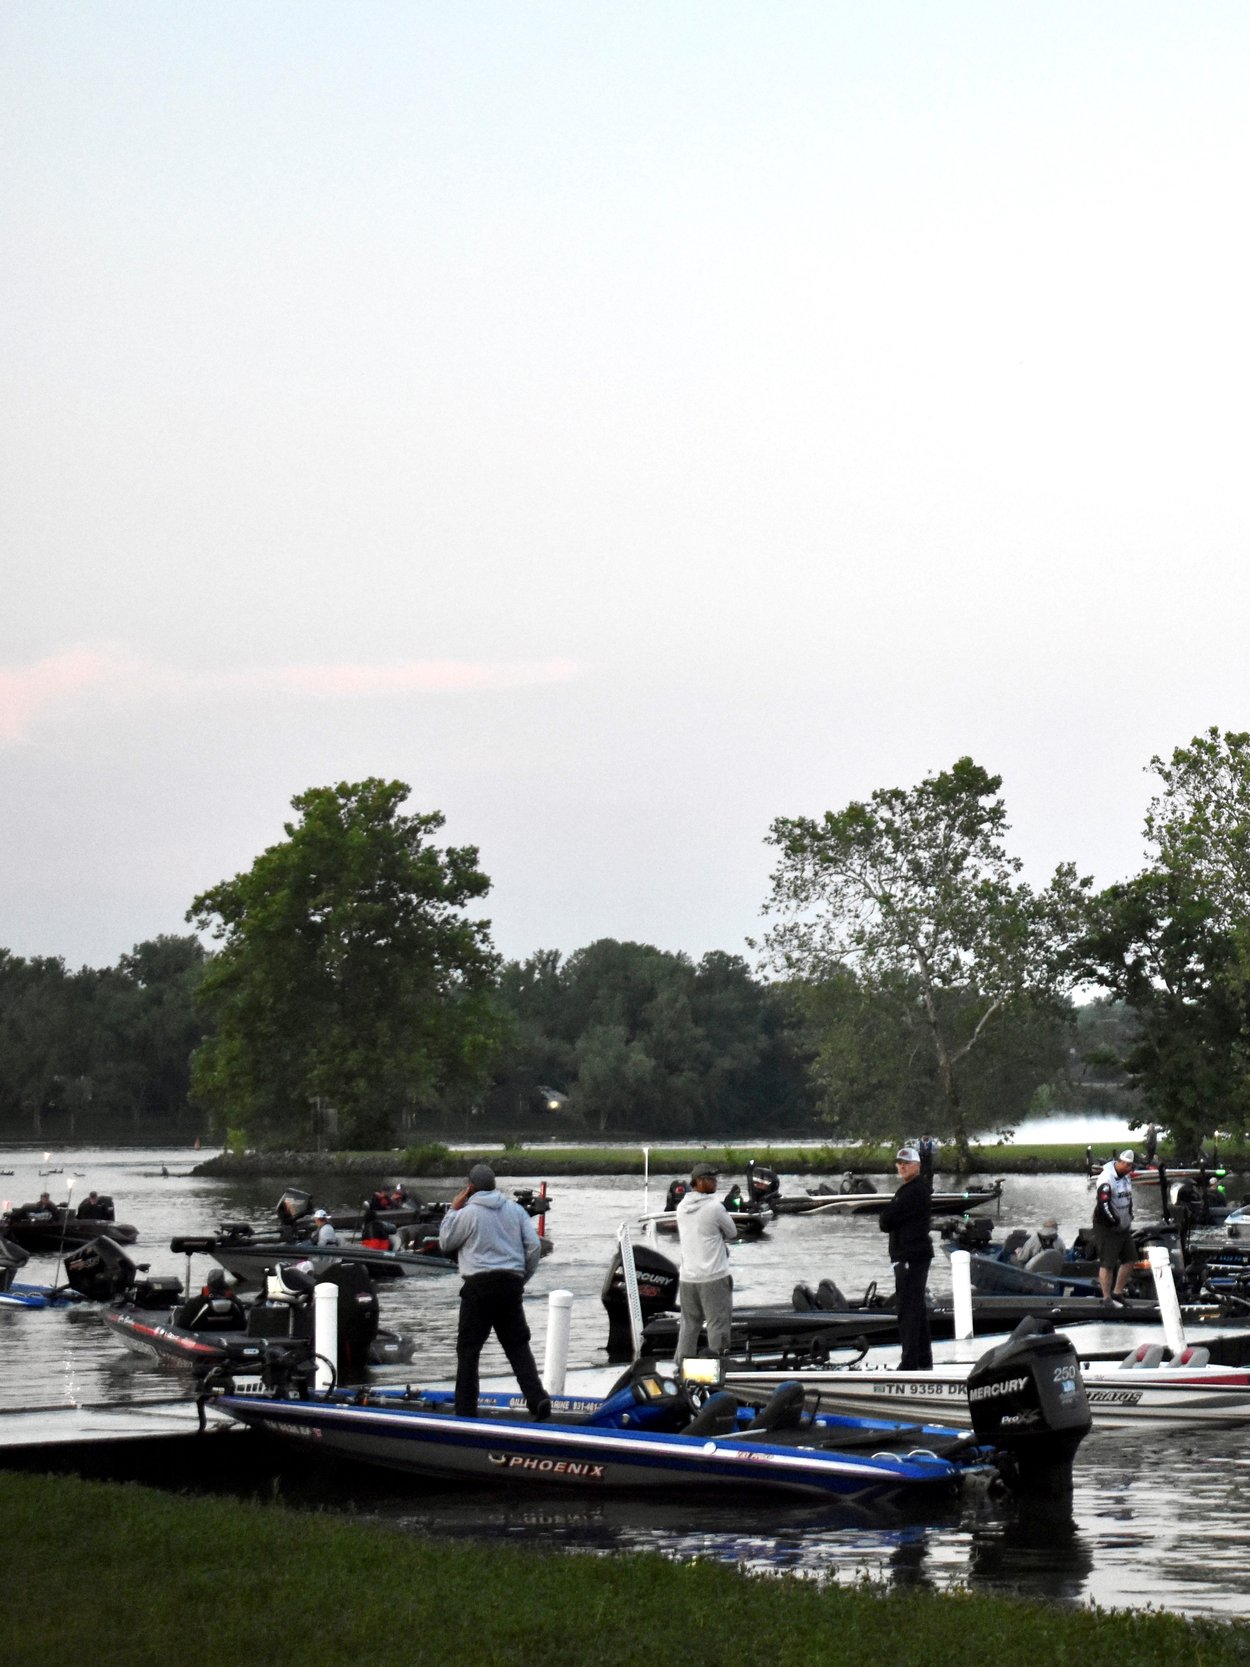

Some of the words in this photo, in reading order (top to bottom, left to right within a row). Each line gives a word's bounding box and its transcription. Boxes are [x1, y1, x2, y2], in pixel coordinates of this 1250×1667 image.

[1053, 1365, 1076, 1382] 250
[886, 1383, 906, 1395] TN
[910, 1384, 944, 1395] 9358
[970, 1376, 1028, 1401] MERCURY
[1086, 1391, 1144, 1404] TRATOS
[509, 1456, 605, 1477] PHOENIX
